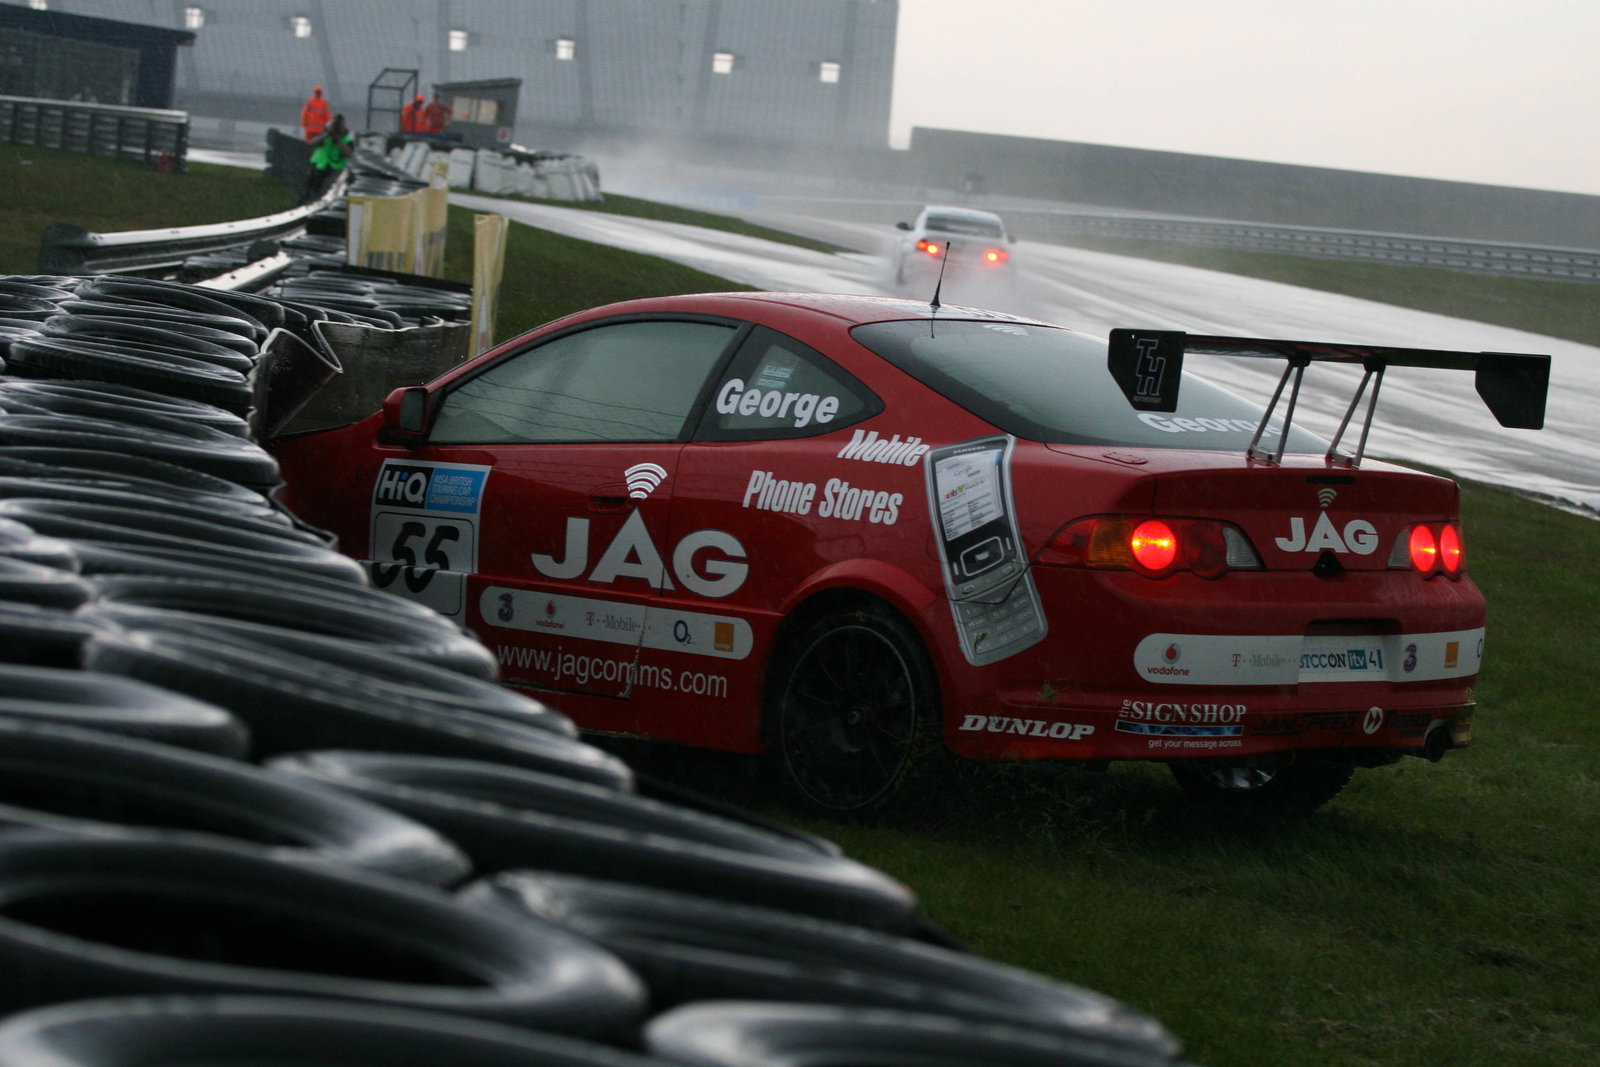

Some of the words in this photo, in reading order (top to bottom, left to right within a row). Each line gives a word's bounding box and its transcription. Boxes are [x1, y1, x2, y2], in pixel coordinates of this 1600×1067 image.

[716, 378, 840, 428] George
[836, 429, 931, 467] Mobile
[377, 469, 427, 504] HiQ
[742, 470, 817, 516] Phone
[818, 478, 904, 526] Stores
[1275, 510, 1379, 555] JAG
[371, 521, 460, 593] 55
[531, 507, 749, 598] JAG
[498, 591, 514, 622] 3
[535, 620, 565, 630] vodafone
[497, 644, 728, 698] www.jagcomms.com
[1147, 666, 1190, 676] vodafone
[1403, 642, 1418, 673] 3
[1118, 699, 1132, 718] the
[959, 714, 1096, 741] DUNLOP
[1148, 739, 1163, 749] get
[1164, 740, 1182, 749] your
[1183, 739, 1218, 750] message
[1219, 738, 1242, 748] across
